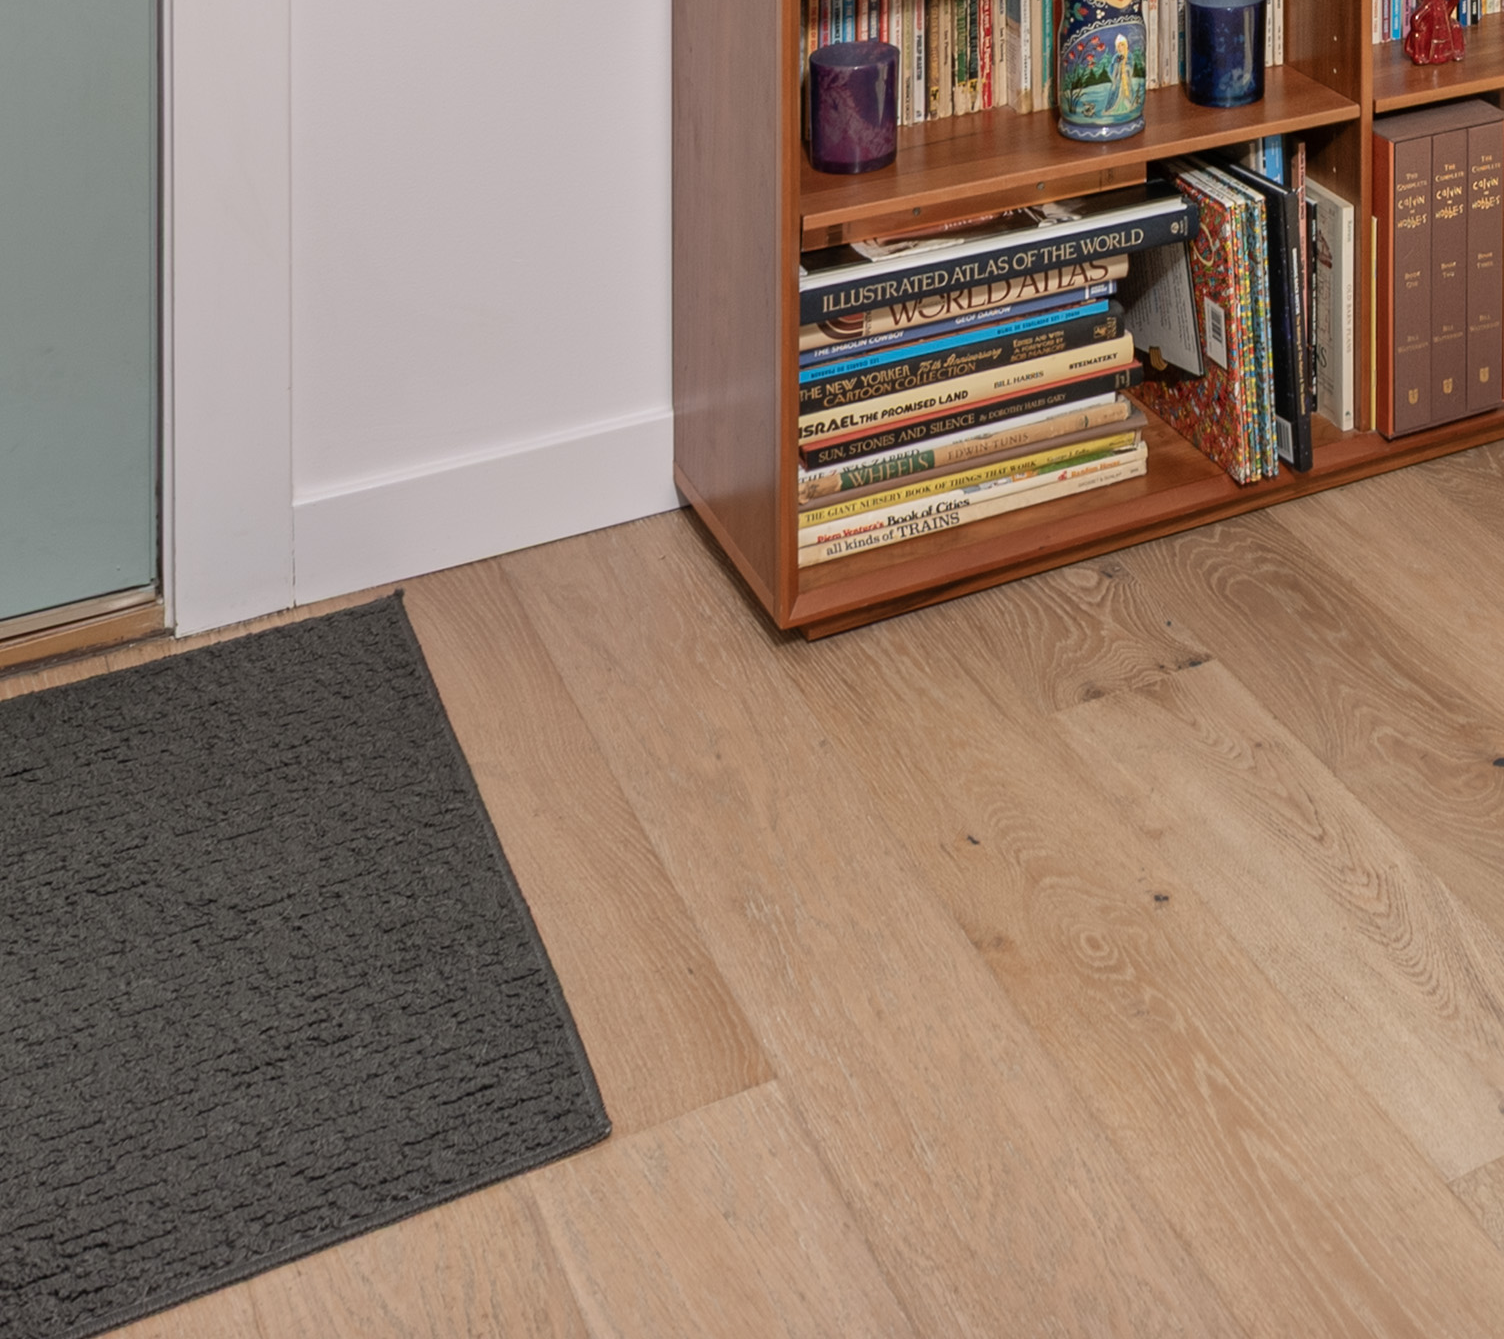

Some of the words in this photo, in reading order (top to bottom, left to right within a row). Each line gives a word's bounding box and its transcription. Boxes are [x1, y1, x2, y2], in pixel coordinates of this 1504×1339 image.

[822, 271, 948, 313] ILLUSTRATED
[952, 257, 1009, 285] ATLAS
[1013, 251, 1037, 270] OF
[1040, 243, 1077, 265] THE
[1081, 228, 1145, 258] WORLD
[889, 278, 1011, 326] WORLD
[869, 331, 904, 345] COWBOY
[798, 412, 860, 439] ISRAEL
[859, 409, 879, 424] THE
[881, 396, 940, 420] PROMISED
[942, 390, 969, 406] LAND
[1013, 370, 1045, 385] HARRIS
[1068, 351, 1120, 371] STEIMATZKY
[799, 383, 823, 401] THE
[825, 376, 859, 396] NEW
[860, 365, 911, 387] YORKER
[918, 357, 941, 375] 75th
[943, 346, 1003, 370] Anniversary
[823, 382, 893, 409] CARTOON
[895, 363, 977, 390] COLLECTION
[817, 446, 847, 464] SUN,
[849, 435, 896, 457] STONES
[898, 426, 927, 443] AND
[930, 412, 976, 434] SILENCE
[988, 403, 1024, 421] DOROTHY
[849, 453, 930, 488] WHEELS
[947, 444, 989, 462] EDWIN
[992, 432, 1029, 454] TUNIS
[805, 511, 825, 524] THE
[827, 503, 857, 518] GIANT
[859, 493, 903, 513] NURSERY
[905, 486, 932, 500] BOOK
[934, 481, 948, 493] OF
[949, 472, 983, 490] THINGS
[985, 466, 1011, 481] THAT
[1010, 459, 1037, 475] WORK
[887, 510, 918, 527] Book
[920, 507, 934, 520] of
[936, 497, 971, 516] Cities
[826, 542, 843, 557] all
[845, 535, 880, 552] kinds
[882, 530, 895, 543] of
[897, 512, 961, 539] TRAINS
